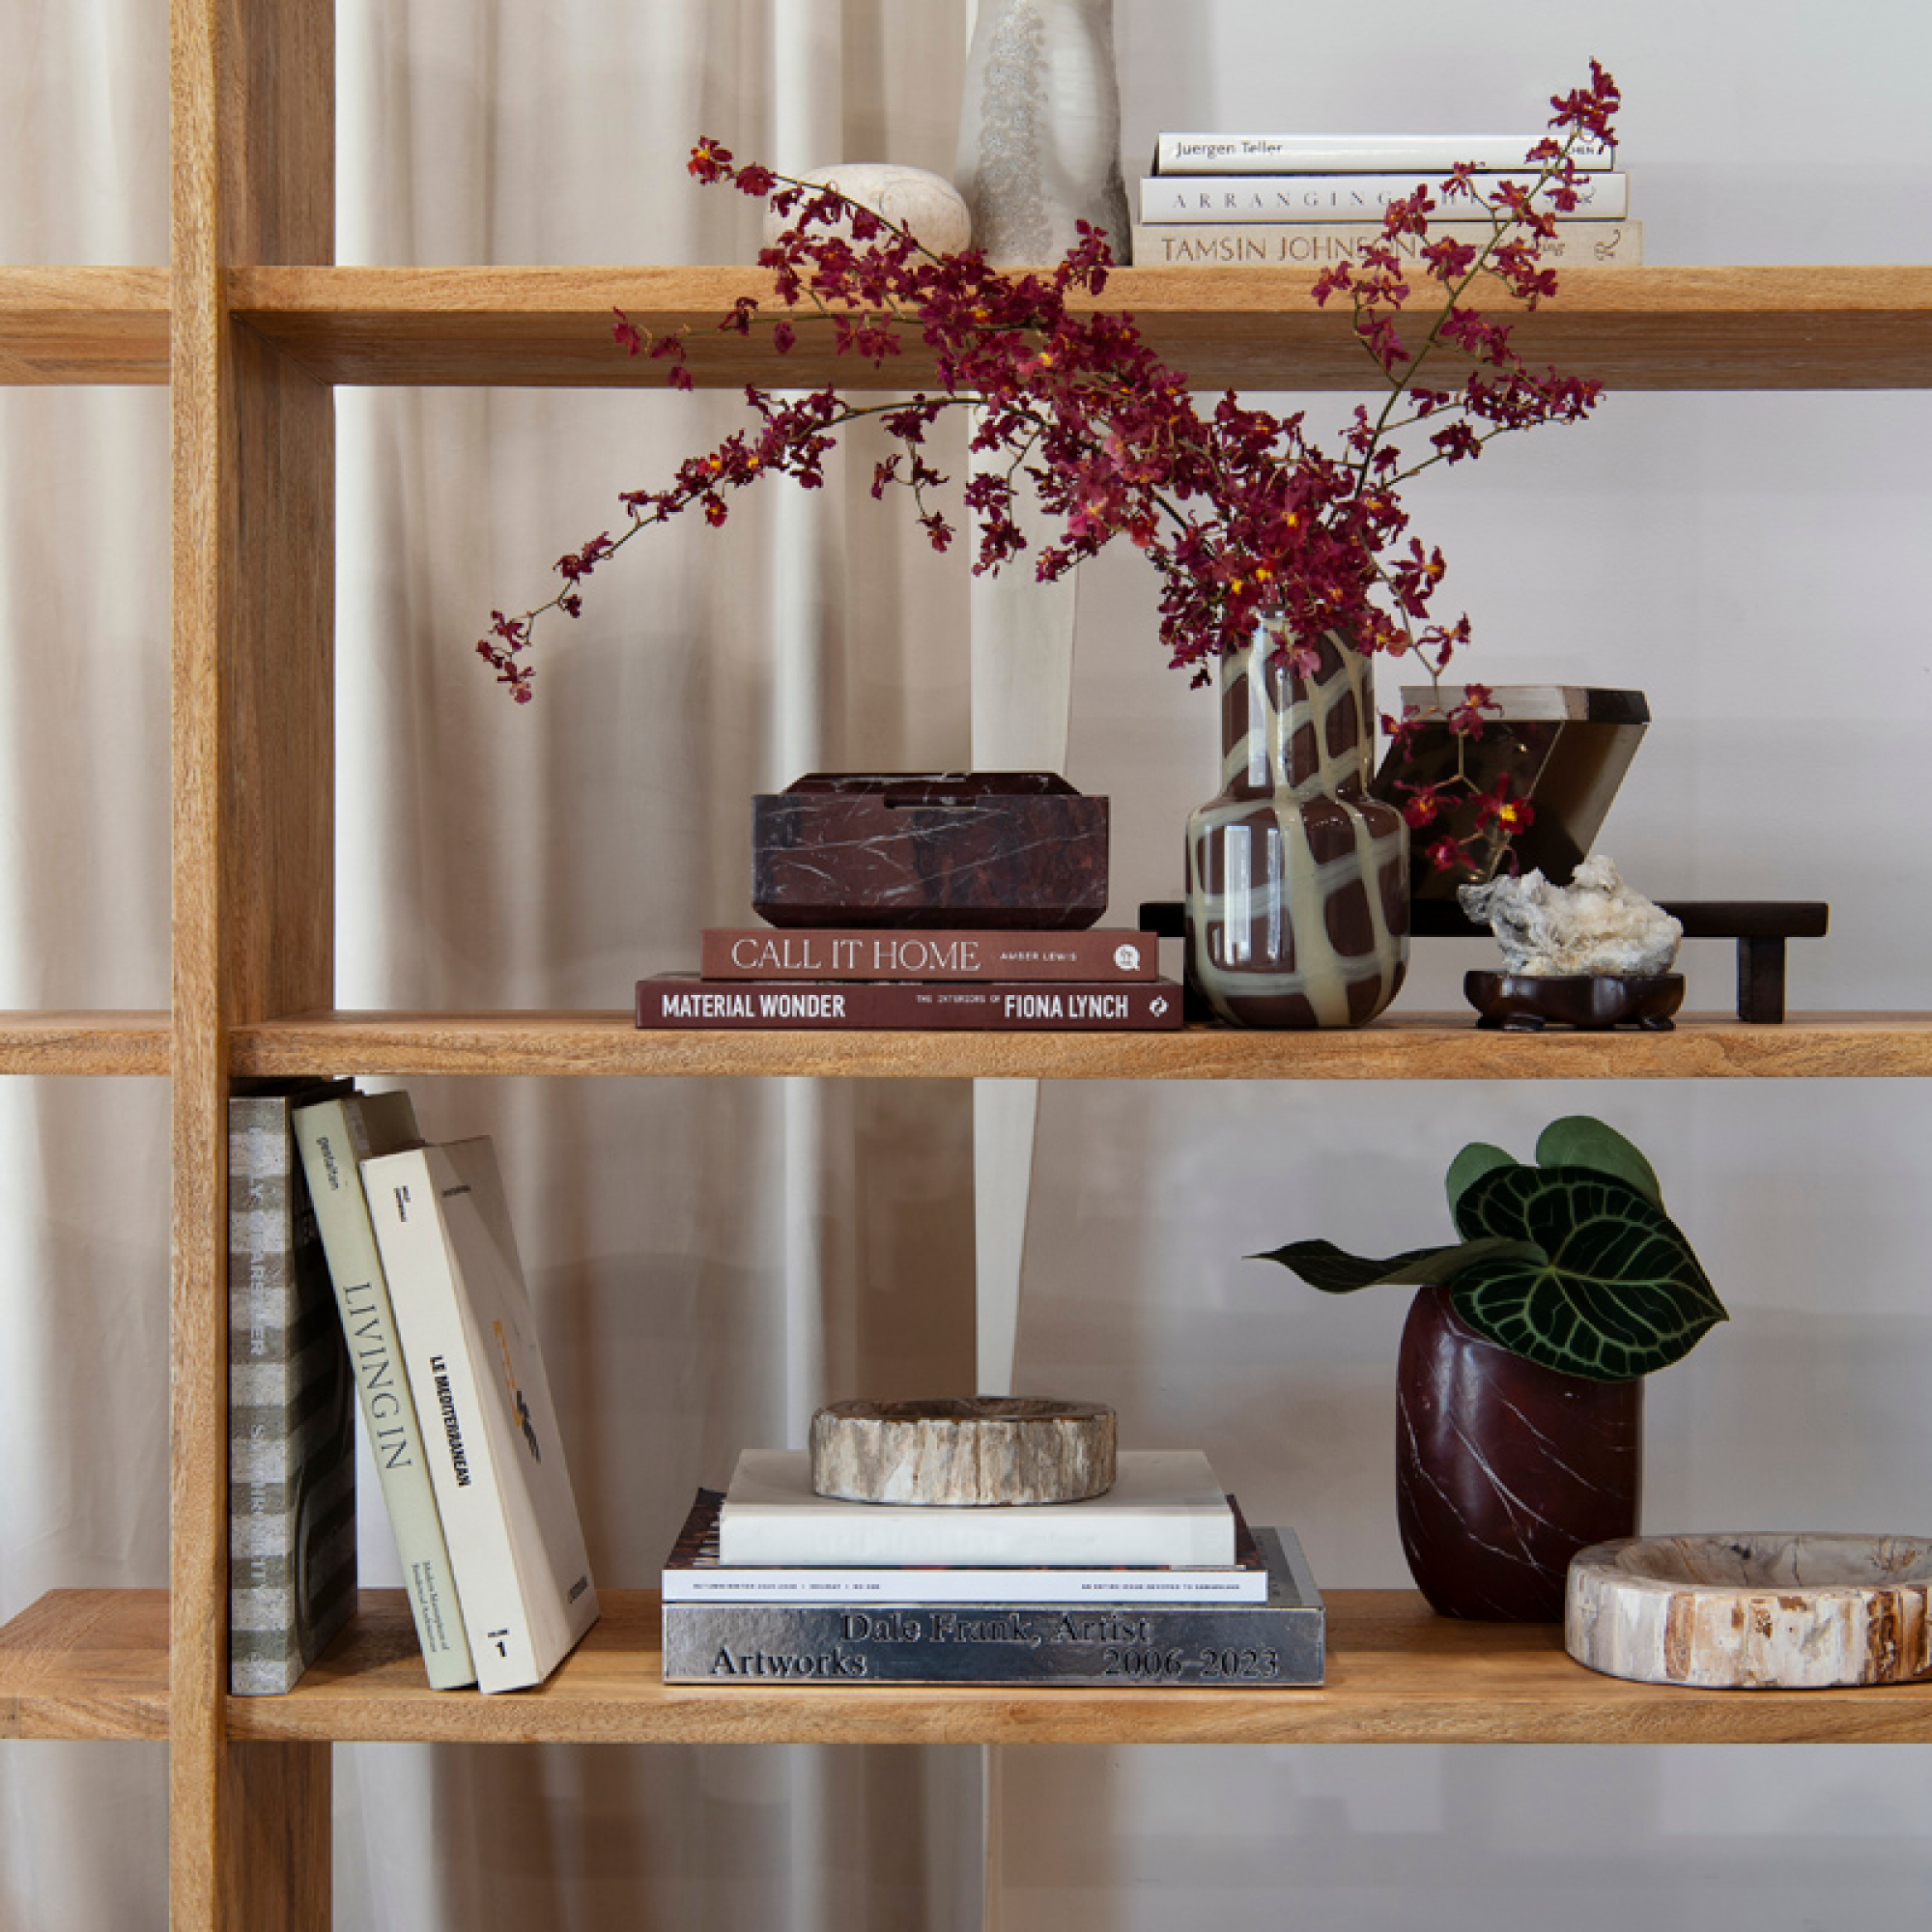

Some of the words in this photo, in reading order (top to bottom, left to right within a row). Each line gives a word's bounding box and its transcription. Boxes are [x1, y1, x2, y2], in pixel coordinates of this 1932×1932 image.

[1176, 141, 1236, 159] Juergen
[1241, 140, 1283, 156] Teller
[1161, 236, 1266, 262] TAMSIN
[1277, 236, 1416, 262] JOHNSN
[731, 938, 821, 970] CALL
[833, 939, 864, 970] IT
[874, 940, 980, 971] HOME
[662, 993, 755, 1018] MATERIAL
[760, 993, 845, 1019] WONDER
[1005, 994, 1064, 1018] FIONA
[1068, 994, 1129, 1018] LYNCH
[342, 1281, 400, 1420] LIVING
[376, 1426, 413, 1469] IN
[839, 1611, 922, 1642] Dale
[929, 1610, 1042, 1649] Frank,
[1056, 1610, 1155, 1644] Artist
[711, 1644, 868, 1678] Artworks
